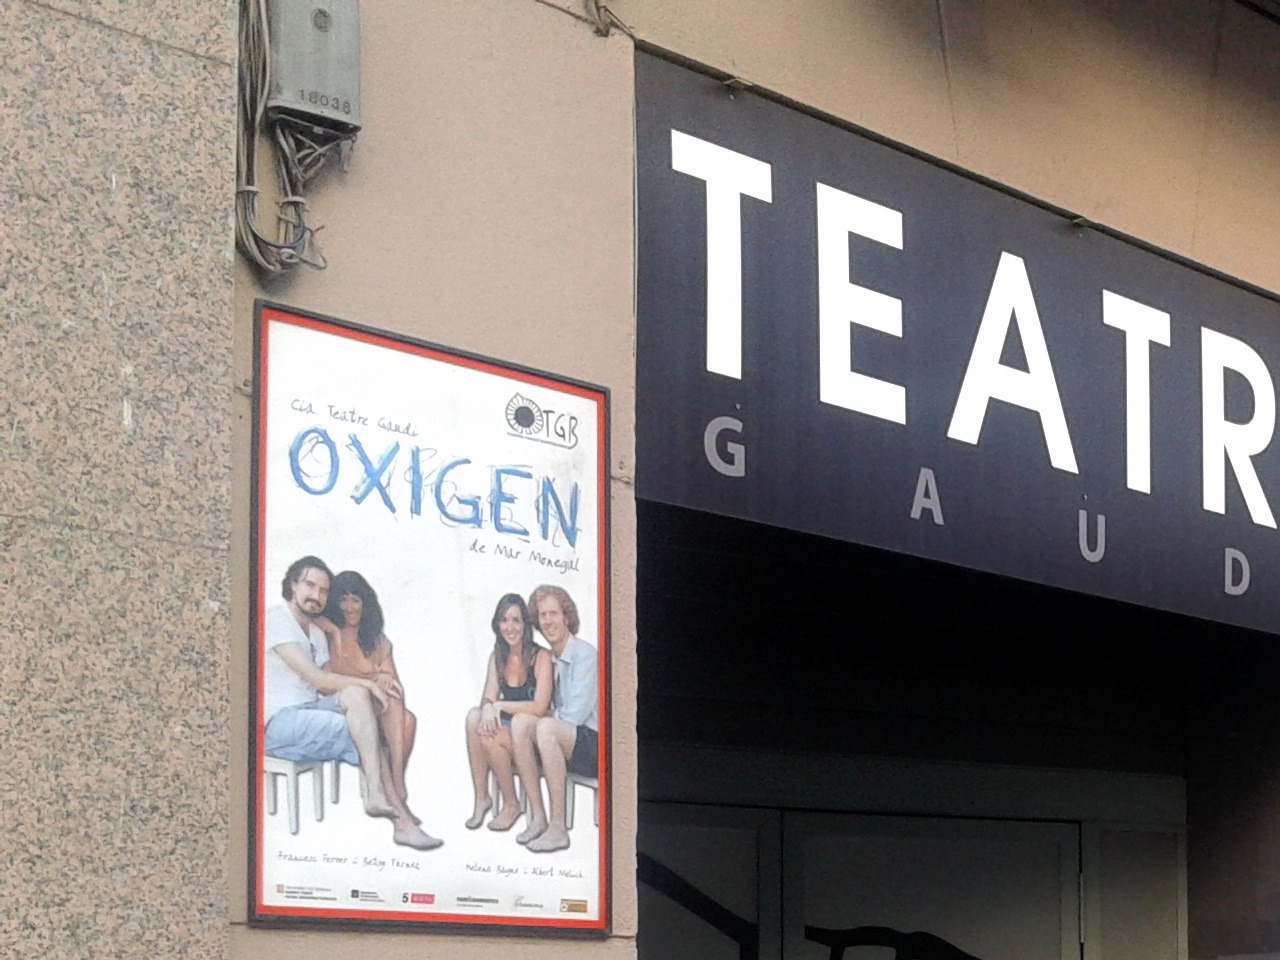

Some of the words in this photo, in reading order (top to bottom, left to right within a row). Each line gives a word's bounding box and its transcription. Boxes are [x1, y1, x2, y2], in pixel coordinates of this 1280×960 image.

[327, 404, 369, 427] Teatre
[289, 425, 581, 549] OXIGEN
[469, 539, 486, 553] de
